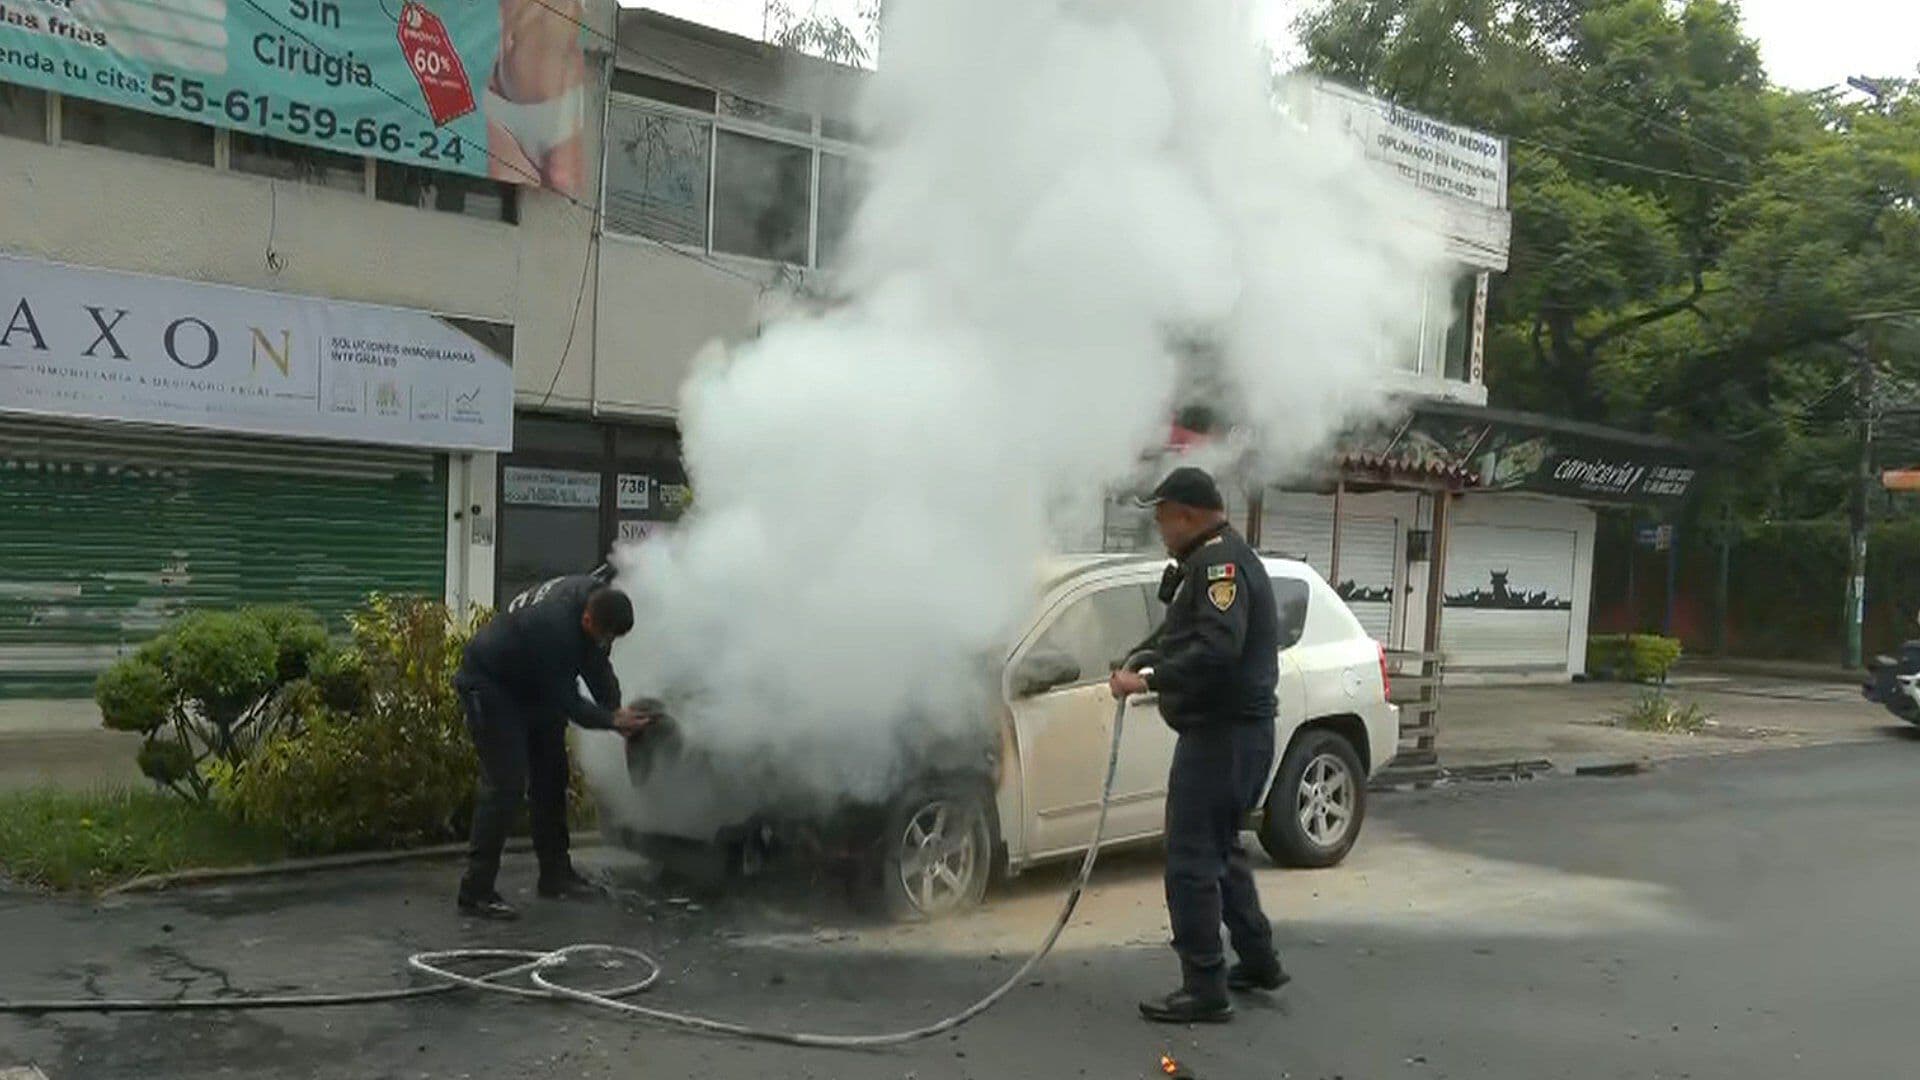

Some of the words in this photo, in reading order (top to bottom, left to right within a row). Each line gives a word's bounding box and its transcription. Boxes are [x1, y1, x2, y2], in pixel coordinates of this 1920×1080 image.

[63, 59, 88, 80] tu
[96, 67, 146, 93] cita:
[151, 73, 465, 164] 55-61-59-66-24
[0, 297, 291, 379] AXON
[331, 337, 400, 355] SOLUCIONES
[331, 351, 398, 368] INTEGRALES
[619, 477, 647, 495] 738
